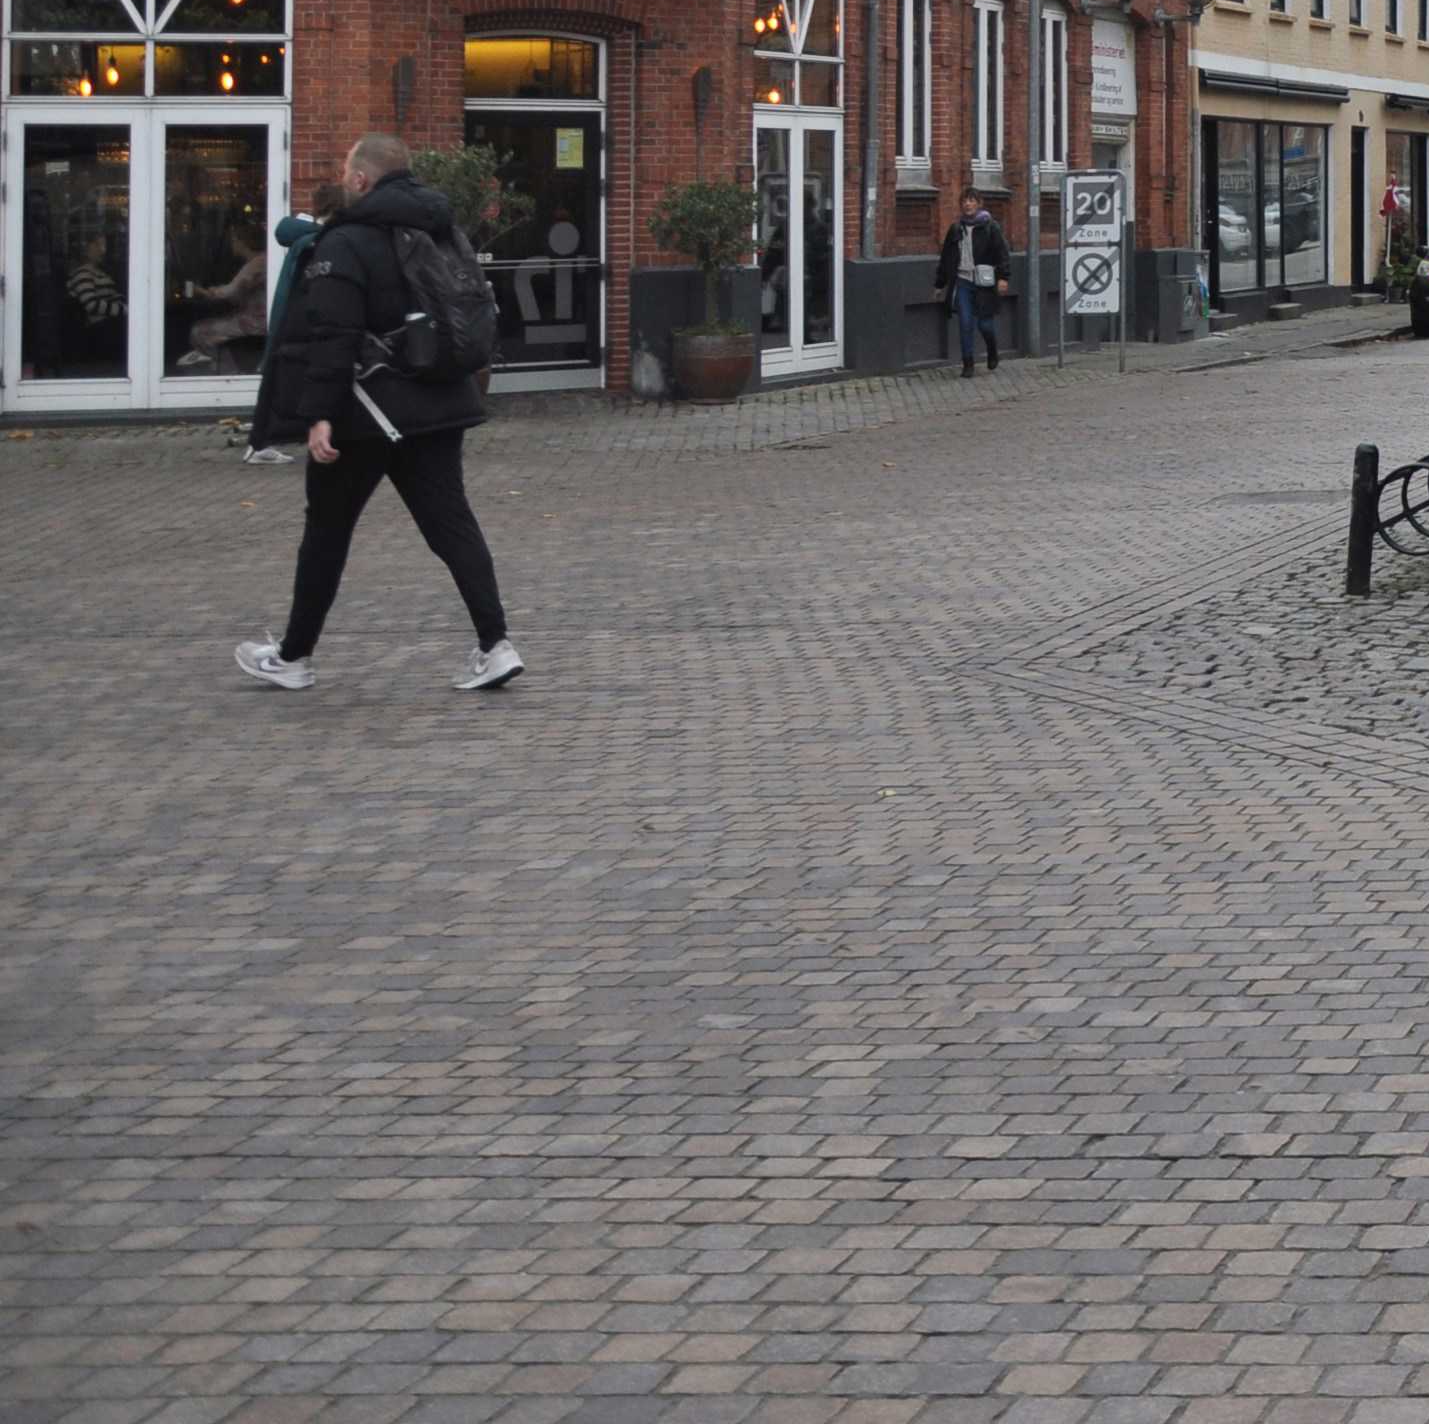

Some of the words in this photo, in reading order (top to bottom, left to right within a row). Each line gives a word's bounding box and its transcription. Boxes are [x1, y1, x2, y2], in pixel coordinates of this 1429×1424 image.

[1075, 191, 1112, 215] 20
[1079, 229, 1108, 237] Zone
[1078, 299, 1107, 308] Zone
